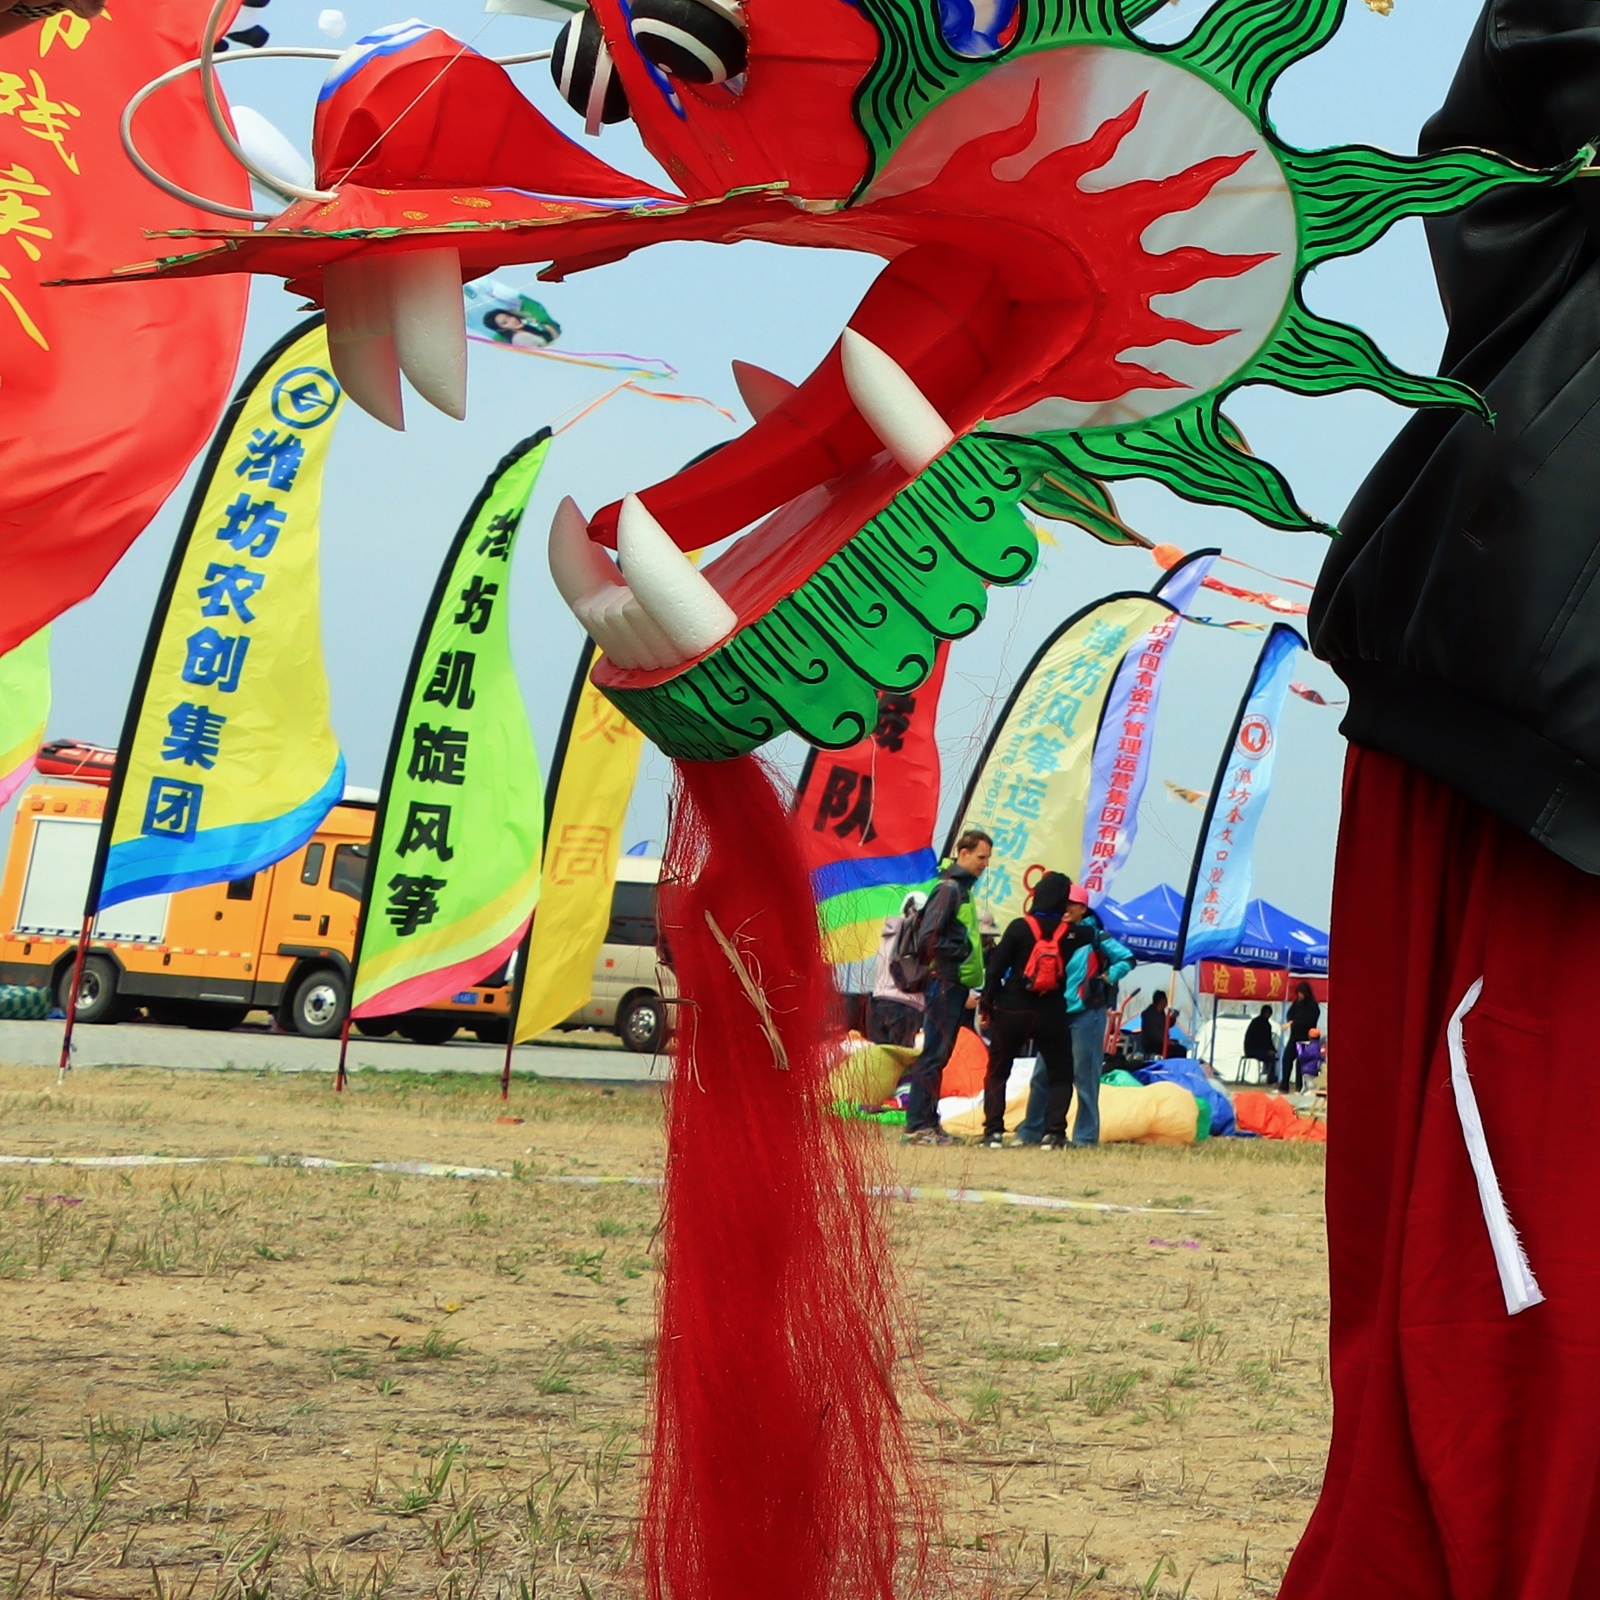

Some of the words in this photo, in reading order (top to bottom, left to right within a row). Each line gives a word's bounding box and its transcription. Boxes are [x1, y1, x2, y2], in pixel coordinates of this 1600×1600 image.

[141, 426, 307, 843] 潍坊农创集团
[1019, 669, 1057, 729] WEIFANG
[1002, 732, 1025, 765] KITE
[980, 769, 1007, 818] SPORT
[1200, 767, 1252, 927] 潍坊奎文口腔医院
